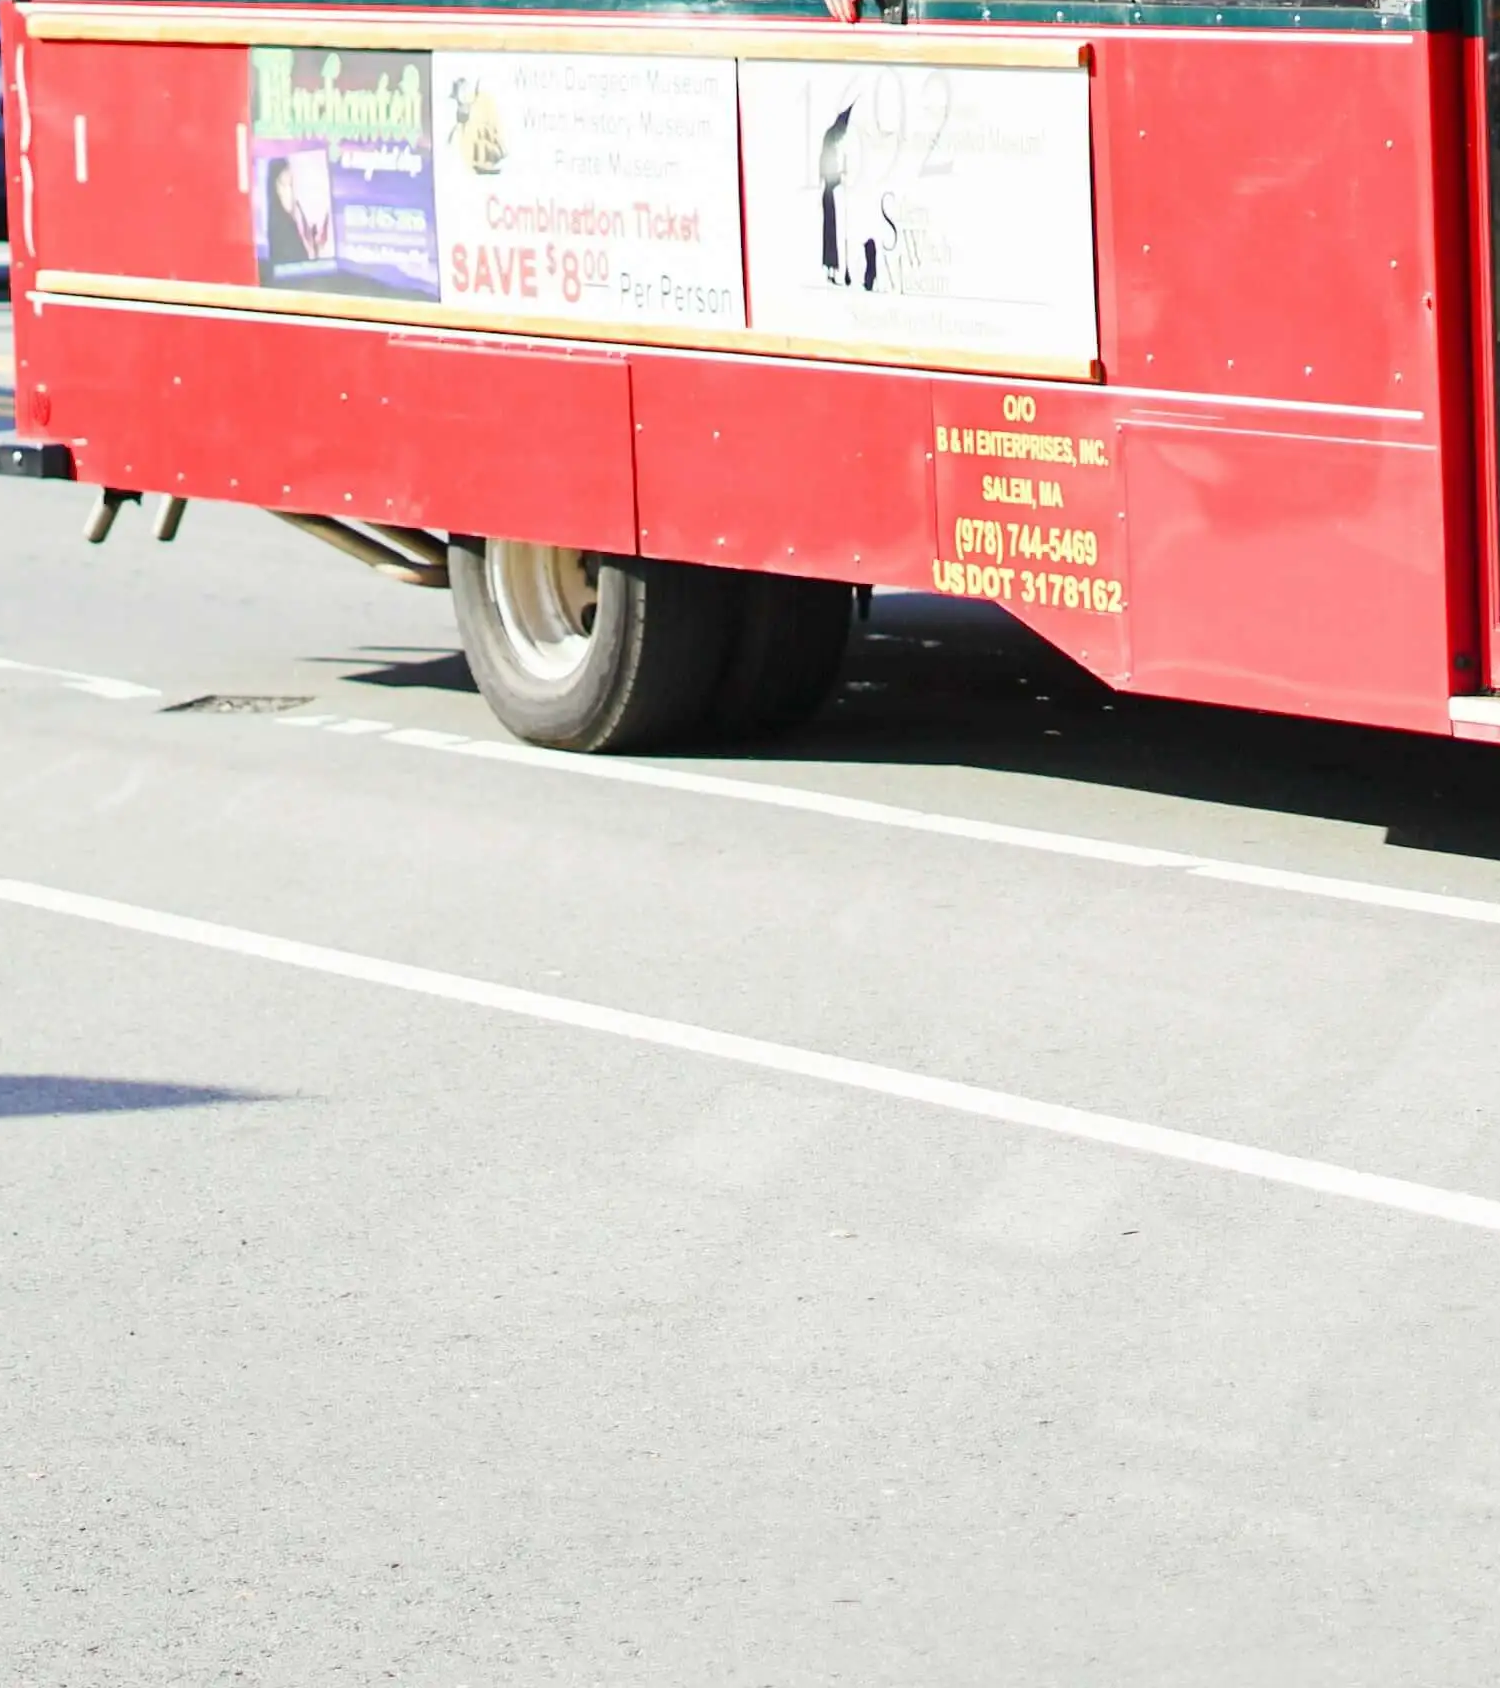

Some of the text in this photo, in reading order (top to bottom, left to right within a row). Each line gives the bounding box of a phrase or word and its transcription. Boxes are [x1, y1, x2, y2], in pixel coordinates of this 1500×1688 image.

[646, 69, 720, 96] Museum
[639, 110, 713, 138] Museum
[486, 194, 702, 244] Combination Ticket
[451, 243, 539, 299] SAVE
[620, 272, 652, 308] Per
[660, 274, 733, 314] Person
[1003, 394, 1036, 422] O/O
[936, 426, 1109, 467] B & H ENTERPRISES, INC.
[982, 475, 1064, 510] SALEM, MA
[955, 517, 1098, 566] (978) 744-5469
[1020, 570, 1123, 614] 3178162
